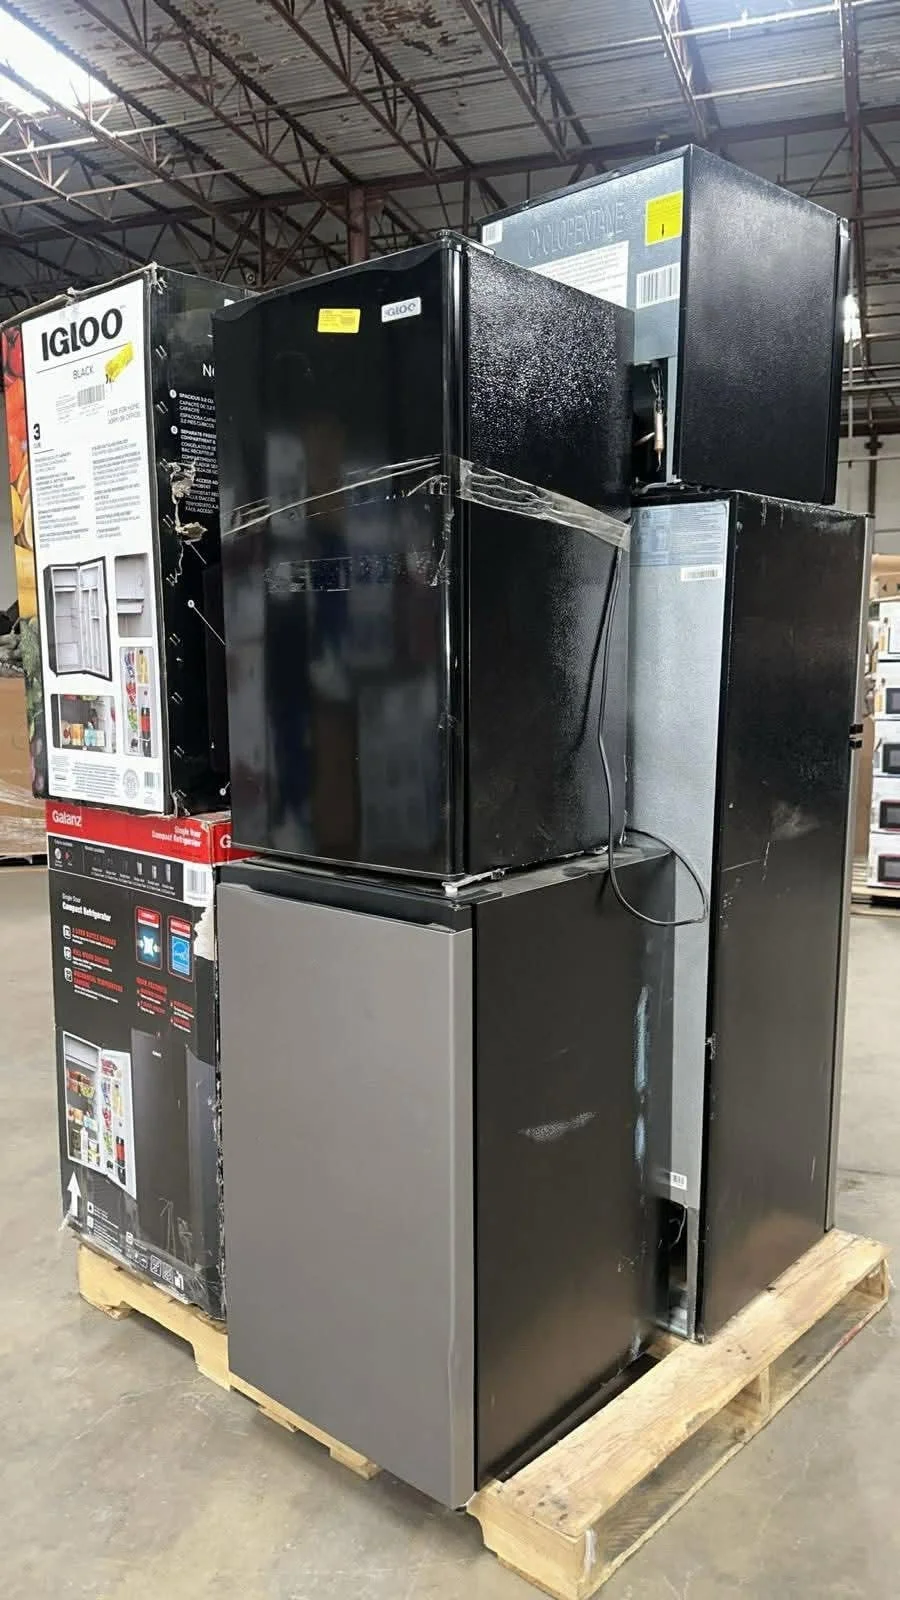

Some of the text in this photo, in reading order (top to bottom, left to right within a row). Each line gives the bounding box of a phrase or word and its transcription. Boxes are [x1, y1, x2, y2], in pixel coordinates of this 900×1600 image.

[528, 201, 625, 259] CYCLOPENTANE
[41, 307, 124, 362] IGLOO
[73, 365, 95, 380] BLACK
[52, 809, 83, 828] Galanz
[152, 829, 201, 847] Compact Refrigerator
[62, 901, 112, 922] Compact Refrigerator
